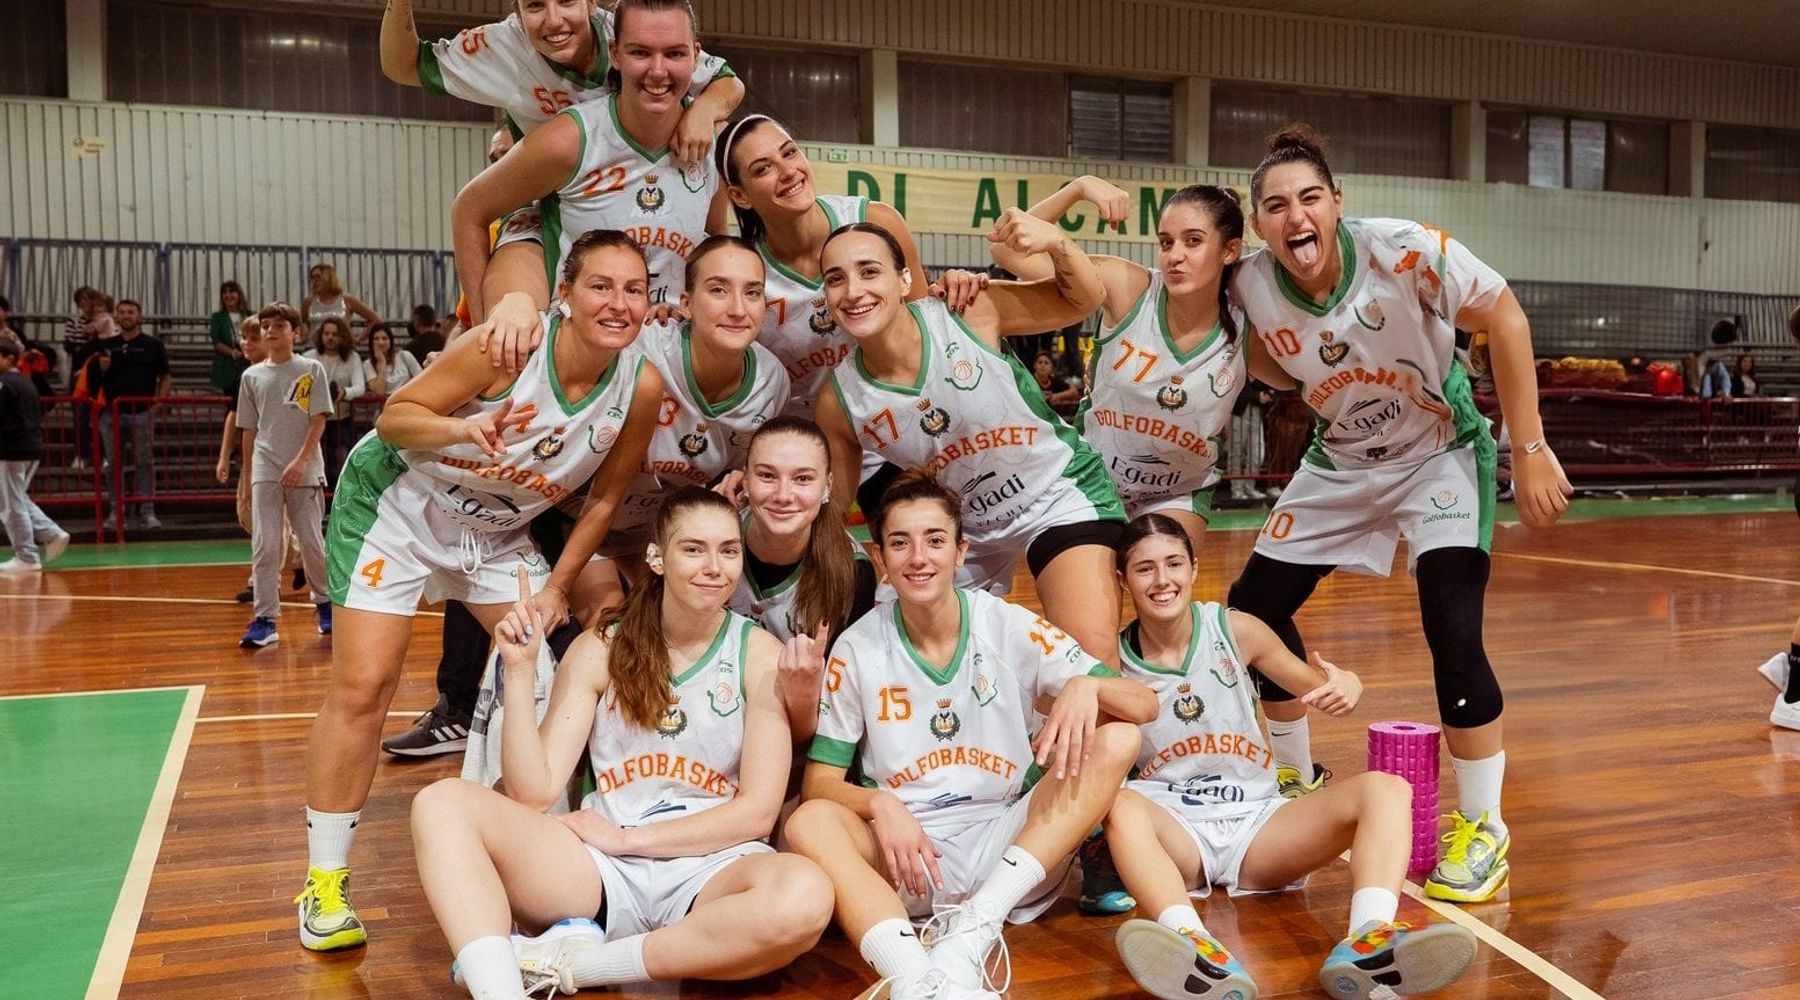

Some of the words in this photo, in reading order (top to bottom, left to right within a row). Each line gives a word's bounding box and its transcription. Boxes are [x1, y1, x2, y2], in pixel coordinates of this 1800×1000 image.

[461, 28, 489, 55] 5
[582, 165, 626, 196] 22
[847, 169, 907, 221] DI
[1264, 328, 1301, 357] 10
[1112, 339, 1158, 384] 77
[863, 407, 900, 449] 17
[928, 427, 1039, 471] OBASKET
[1111, 456, 1182, 487] Egadi
[965, 473, 1026, 517] gadi
[1422, 512, 1471, 525] Golfobasket
[361, 557, 386, 588] 4
[826, 655, 847, 693] 5
[877, 685, 911, 722] 15
[597, 752, 740, 799] OLFOBASKET
